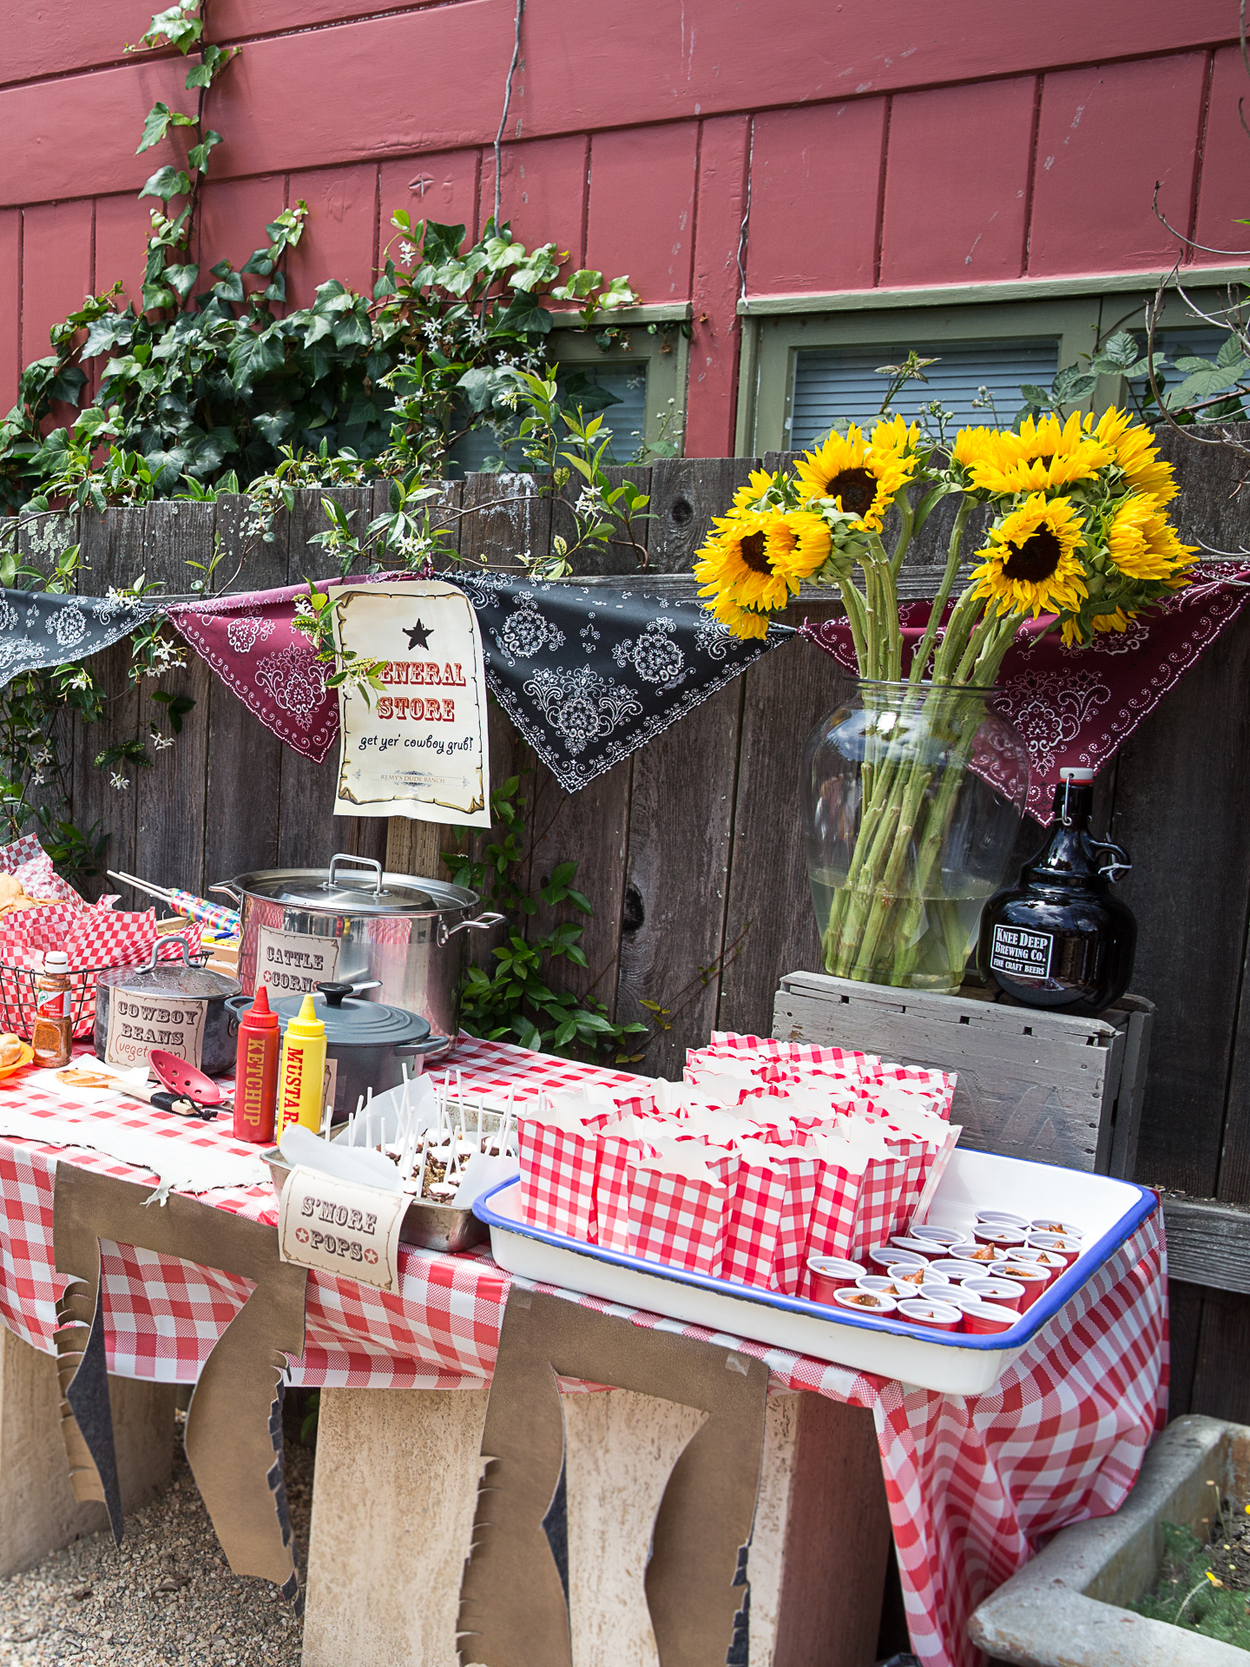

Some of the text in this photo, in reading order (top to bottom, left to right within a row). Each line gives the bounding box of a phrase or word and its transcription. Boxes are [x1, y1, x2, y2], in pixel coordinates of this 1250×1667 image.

[364, 661, 467, 687] ENERAL
[377, 696, 455, 723] STORE
[358, 735, 378, 751] get
[403, 734, 445, 755] cowboy
[446, 736, 474, 756] grub!
[403, 775, 422, 783] DUDE
[266, 946, 324, 971] CATTLE
[993, 958, 1045, 975] FINE CRAFT BEERS
[272, 971, 313, 993] CORN
[117, 1001, 198, 1025] COWBOY
[121, 1023, 184, 1046] BEANS
[115, 1034, 187, 1062] (vegetn)
[243, 1038, 265, 1126] KETCHUP
[282, 1046, 304, 1131] MUSTAR
[301, 1195, 378, 1235] S'MORE
[310, 1229, 363, 1262] POPS
